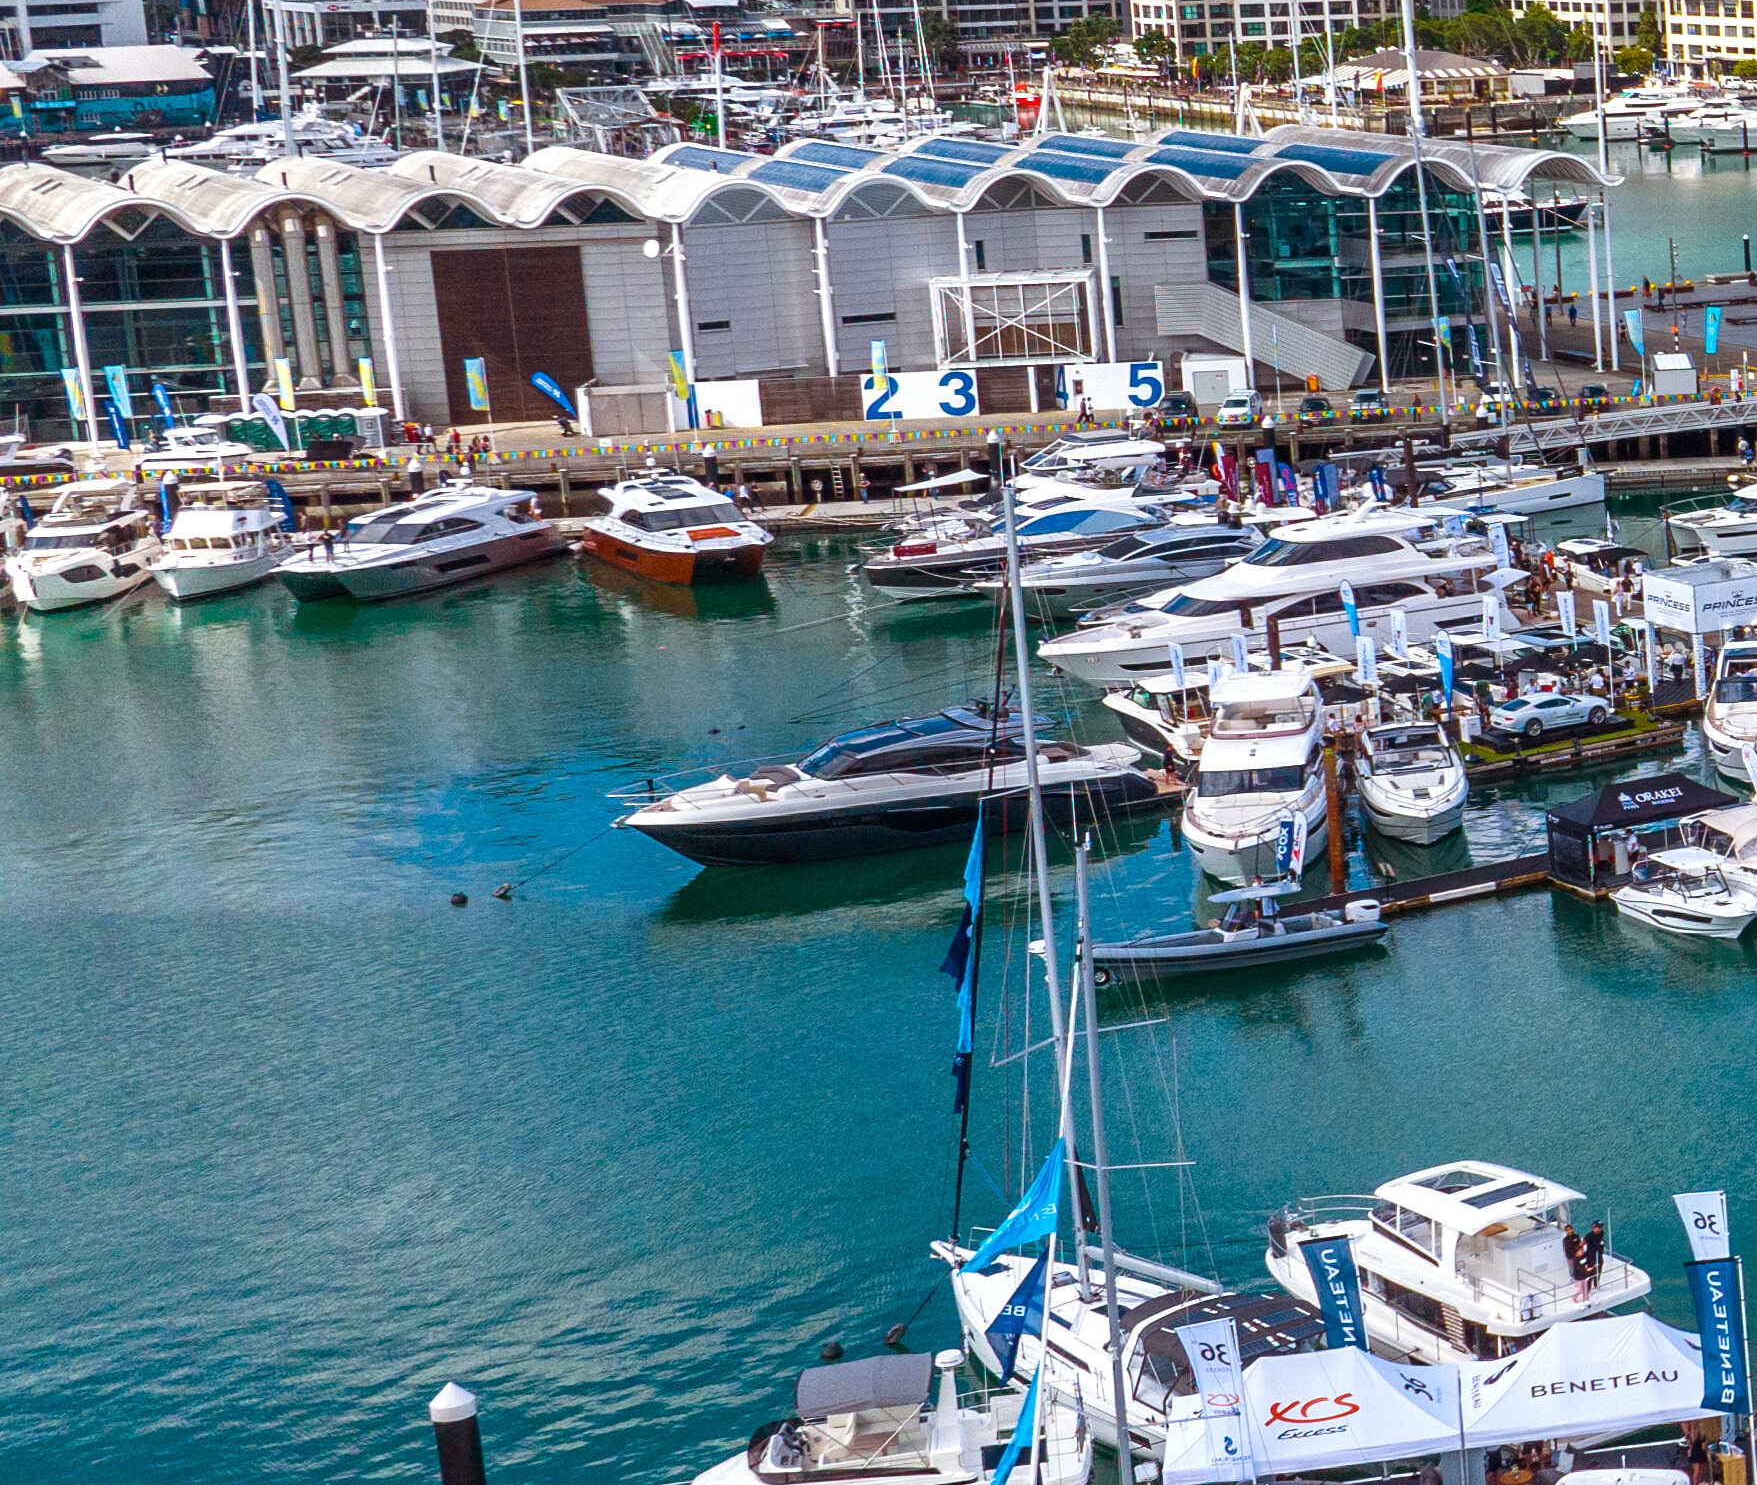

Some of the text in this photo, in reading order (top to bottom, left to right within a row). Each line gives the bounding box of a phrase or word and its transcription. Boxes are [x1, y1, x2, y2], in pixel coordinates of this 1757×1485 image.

[863, 371, 977, 421] 2 3
[1128, 362, 1163, 408] 5
[1646, 594, 1691, 614] PRINCESS
[1635, 786, 1684, 803] ORAKEI
[1529, 1370, 1680, 1398] BENETEAU
[1276, 1423, 1349, 1442] Excess
